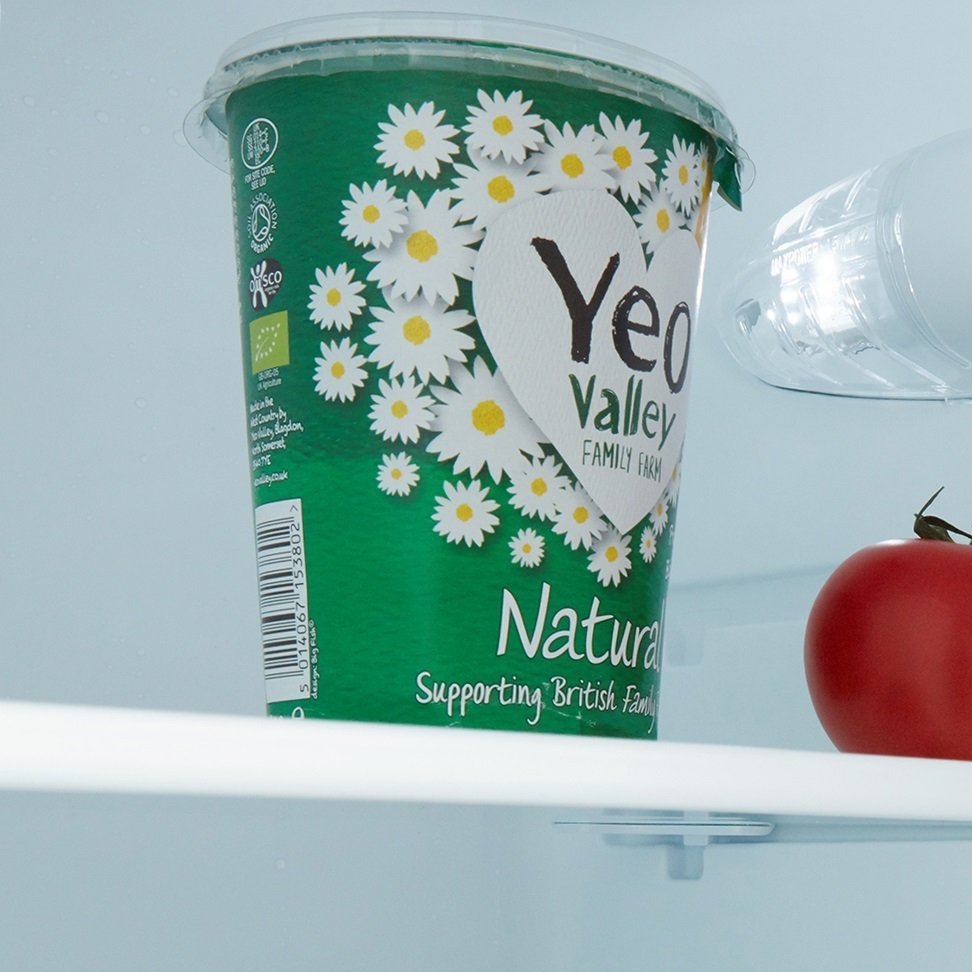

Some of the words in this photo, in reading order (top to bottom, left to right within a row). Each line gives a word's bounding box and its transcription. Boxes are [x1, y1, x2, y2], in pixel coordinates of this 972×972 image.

[530, 236, 692, 394] Yeo
[568, 373, 677, 450] Valley
[582, 439, 632, 473] FAMILY
[638, 451, 662, 483] FARM
[289, 522, 305, 589] 153802
[295, 600, 310, 670] 014067
[299, 683, 310, 693] 5
[415, 671, 542, 725] Supporting
[550, 675, 617, 711] British
